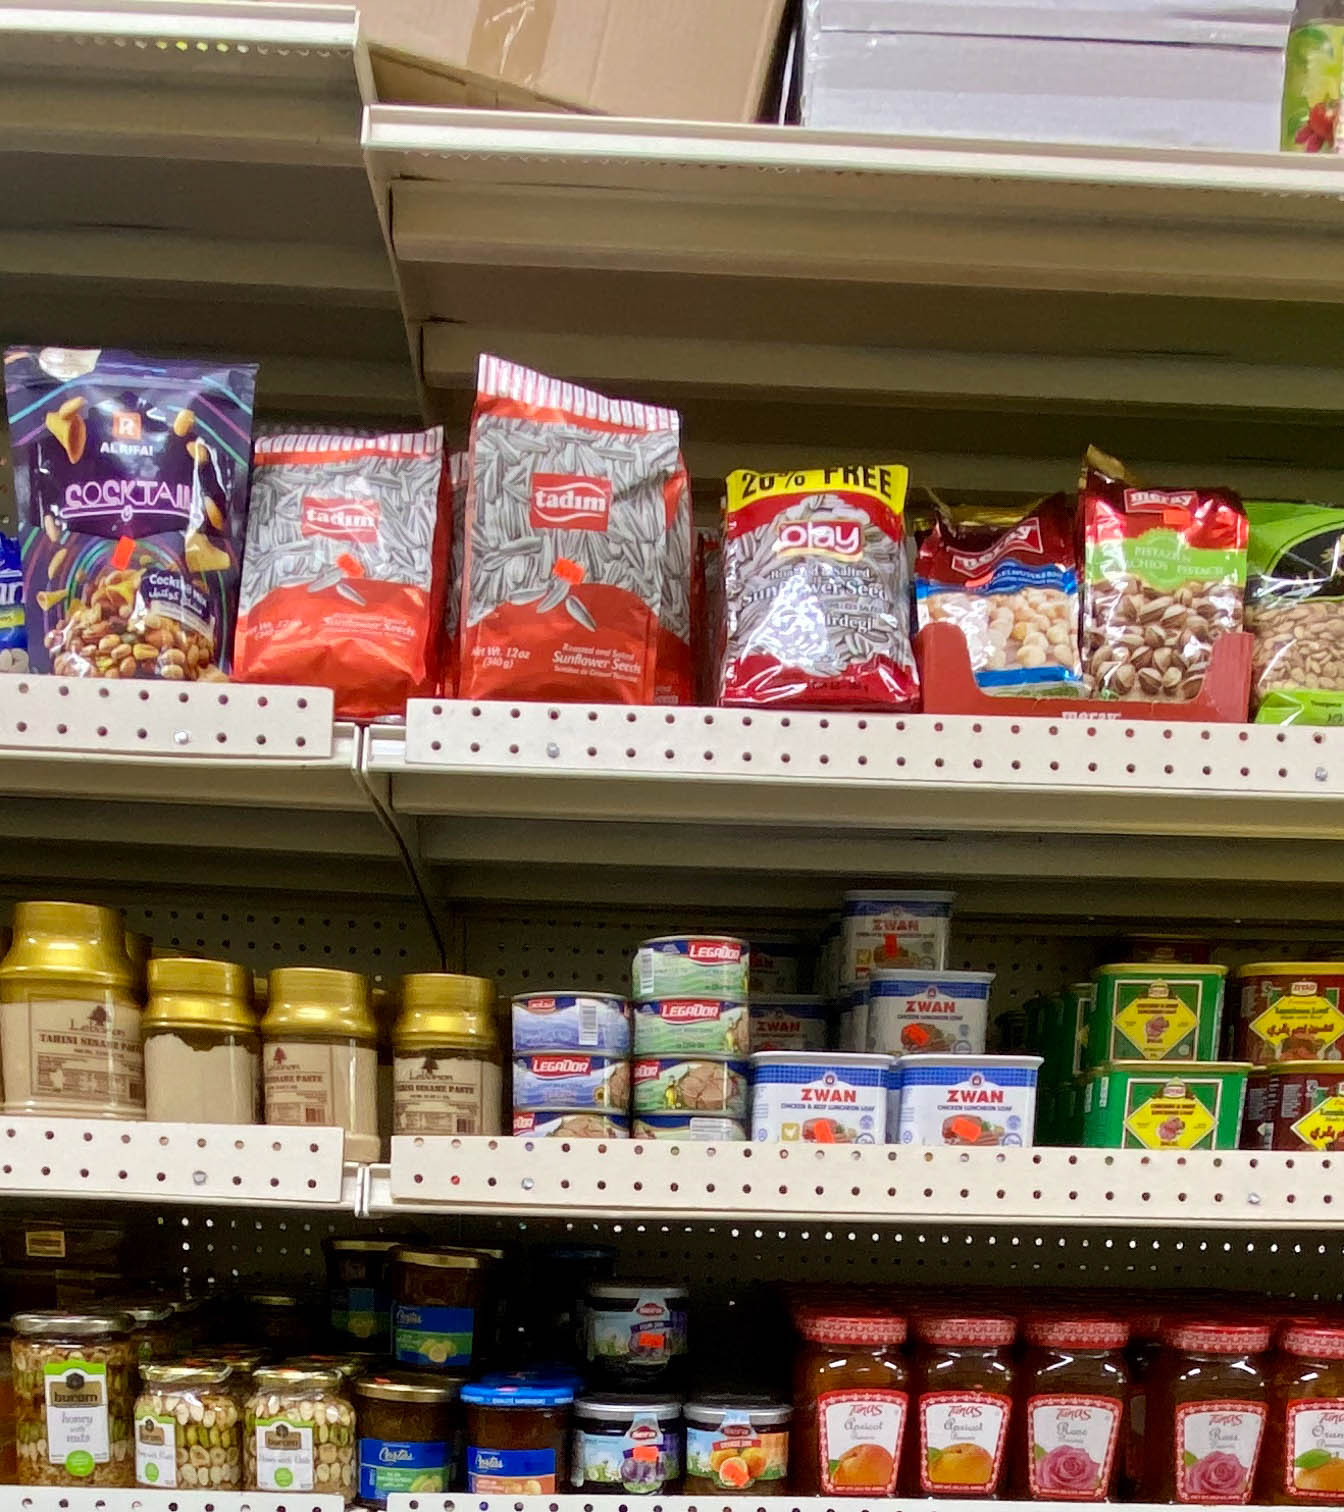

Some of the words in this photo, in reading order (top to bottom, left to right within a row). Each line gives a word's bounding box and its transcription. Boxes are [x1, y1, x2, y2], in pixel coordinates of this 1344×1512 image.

[872, 918, 920, 932] ZWAN
[660, 1002, 721, 1020] LEGADOR
[904, 1000, 957, 1014] ZWAN
[531, 1056, 590, 1075] LEGADOR
[800, 1088, 858, 1104] ZWAN
[946, 1089, 1005, 1104] ZWAN
